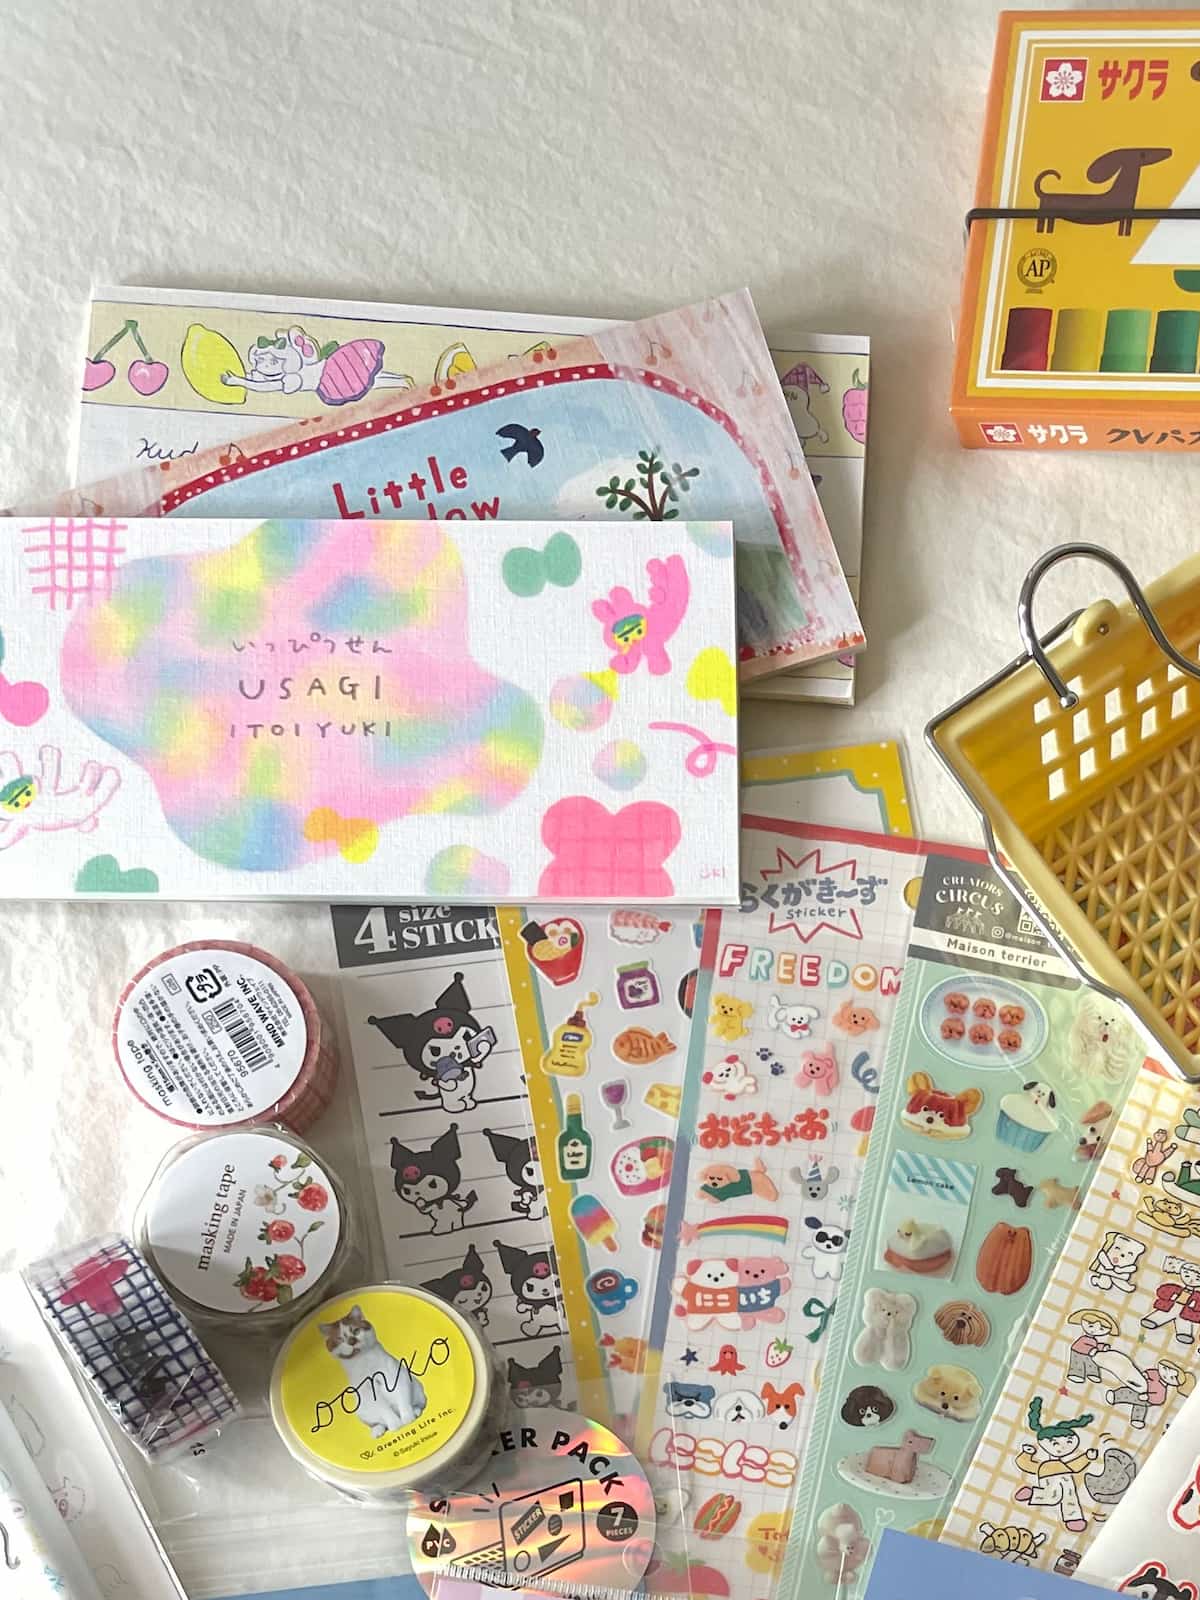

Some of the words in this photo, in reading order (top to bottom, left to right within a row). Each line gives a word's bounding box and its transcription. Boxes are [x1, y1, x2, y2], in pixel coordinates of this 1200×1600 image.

[1098, 59, 1169, 100] サクラ
[1027, 424, 1088, 443] サクラ
[333, 455, 469, 519] Little
[239, 676, 382, 701] USAGI
[230, 722, 300, 739] ITOI
[317, 719, 393, 738] YUKI
[936, 890, 1004, 916] CIRCUS
[354, 907, 398, 955] 4
[946, 937, 994, 957] Maison
[998, 949, 1048, 968] terrier
[247, 995, 267, 1024] WAVE
[266, 1022, 286, 1050] MIND
[198, 1205, 222, 1273] masking
[217, 1163, 237, 1212] tape
[552, 1431, 624, 1495] PACK
[513, 1506, 543, 1541] STICKER
[609, 1507, 626, 1528] 7
